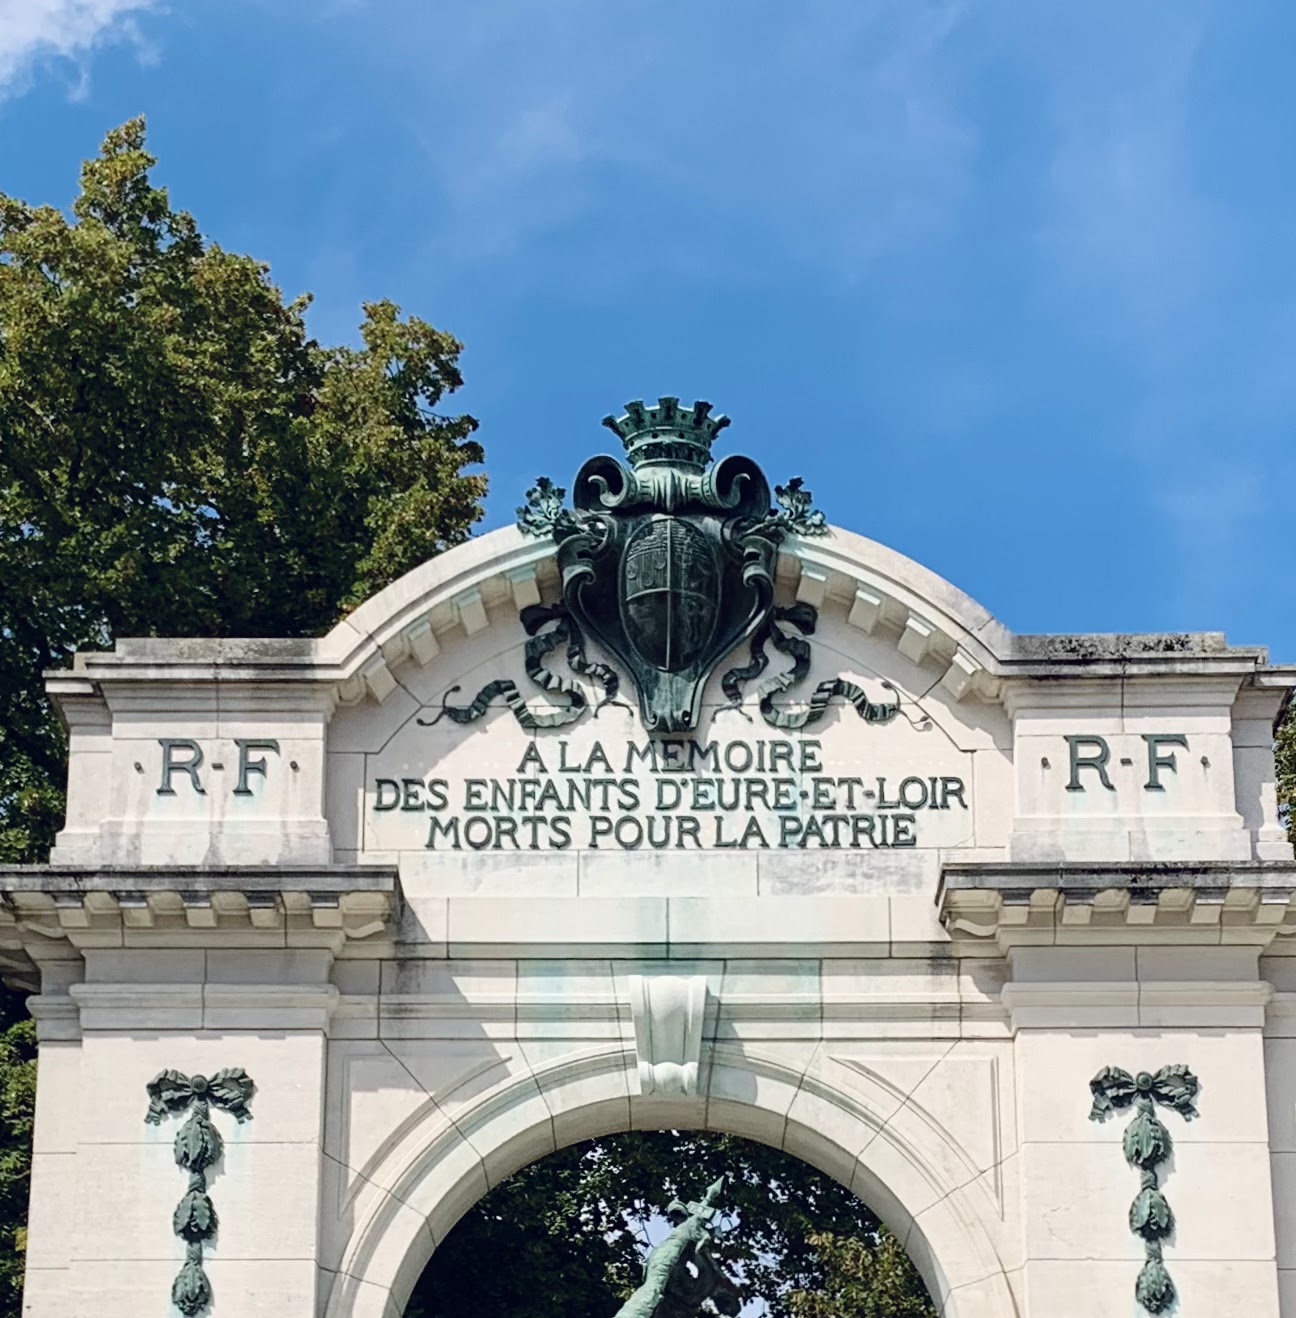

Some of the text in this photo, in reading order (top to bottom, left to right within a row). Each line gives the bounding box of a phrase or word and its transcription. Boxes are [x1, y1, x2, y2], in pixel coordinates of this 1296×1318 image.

[516, 740, 823, 773] A LA MEMOIRE
[373, 778, 449, 812] DES
[463, 778, 640, 812] ENFANTS
[425, 814, 917, 850] MORTS POUR LA PATRIE
